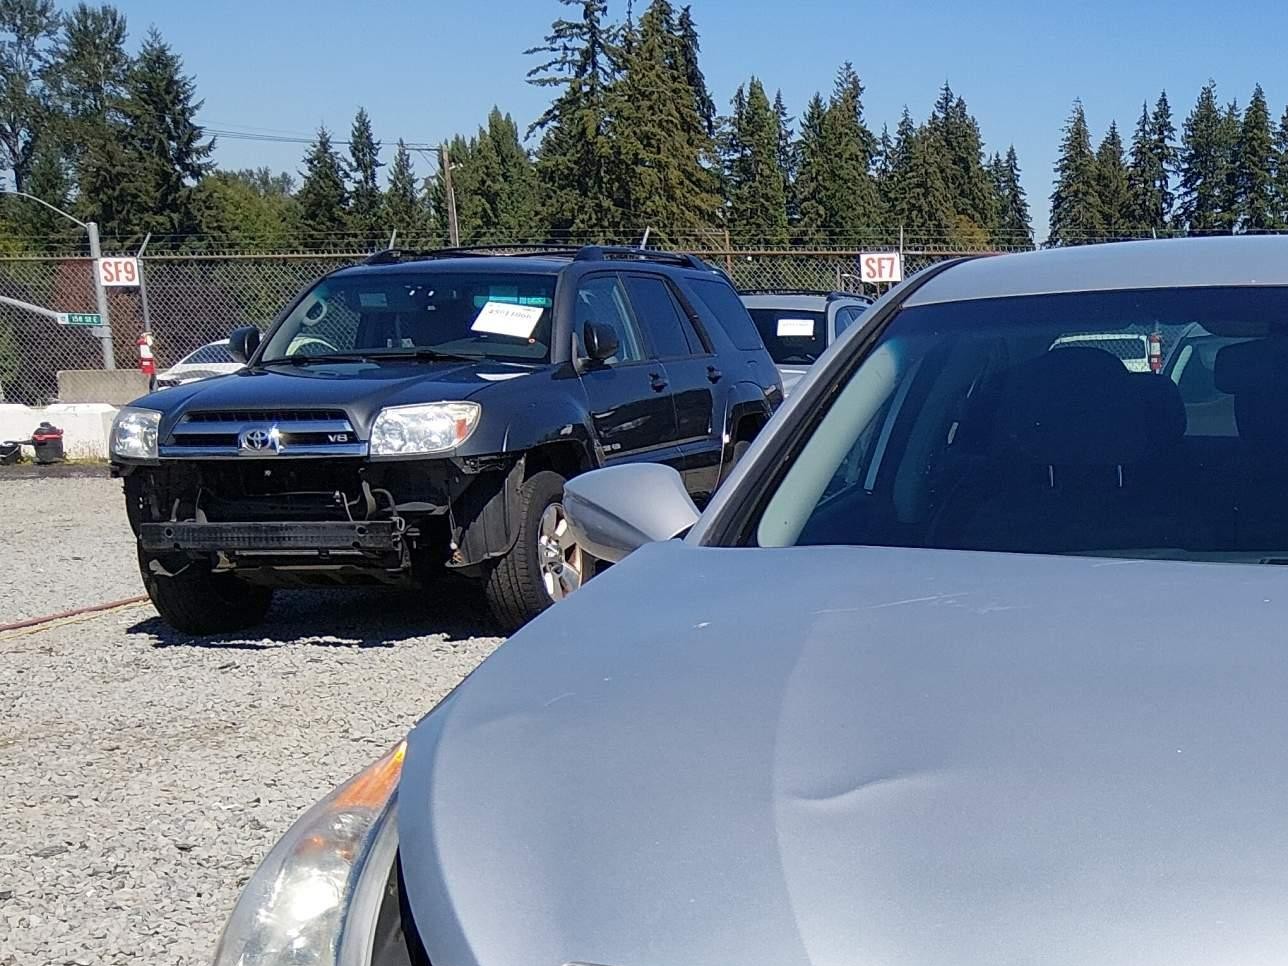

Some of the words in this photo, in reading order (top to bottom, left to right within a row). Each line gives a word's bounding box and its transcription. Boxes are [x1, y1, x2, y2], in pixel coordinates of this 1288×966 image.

[102, 261, 135, 282] SF9
[865, 257, 895, 278] SF7
[328, 434, 348, 442] V8
